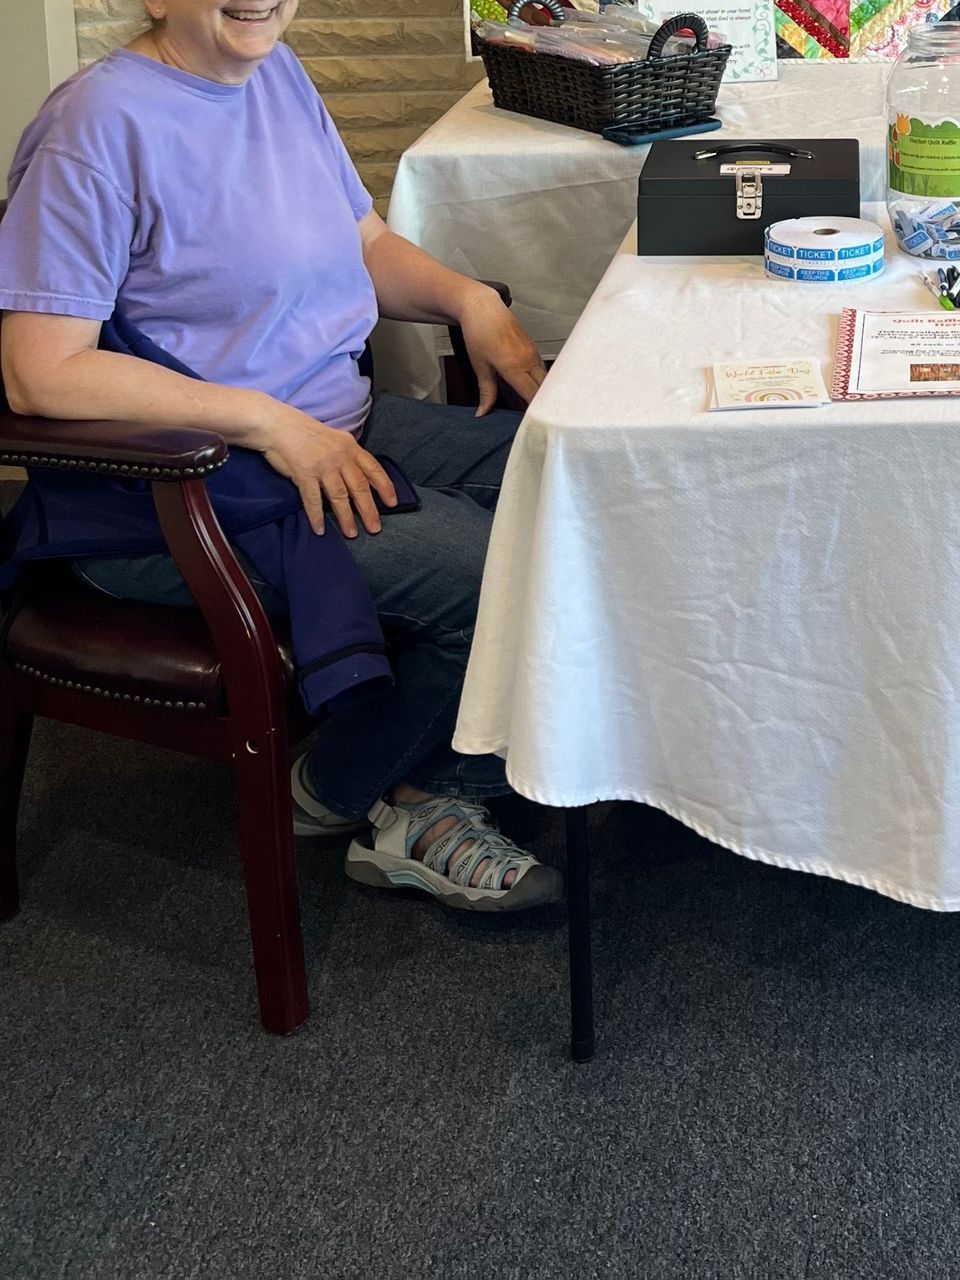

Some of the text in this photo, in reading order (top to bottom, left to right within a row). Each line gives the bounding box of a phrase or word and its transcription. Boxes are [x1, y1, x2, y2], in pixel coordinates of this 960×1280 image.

[769, 242, 792, 256] TICKET
[799, 250, 833, 259] TICKET
[841, 245, 870, 257] TICKET
